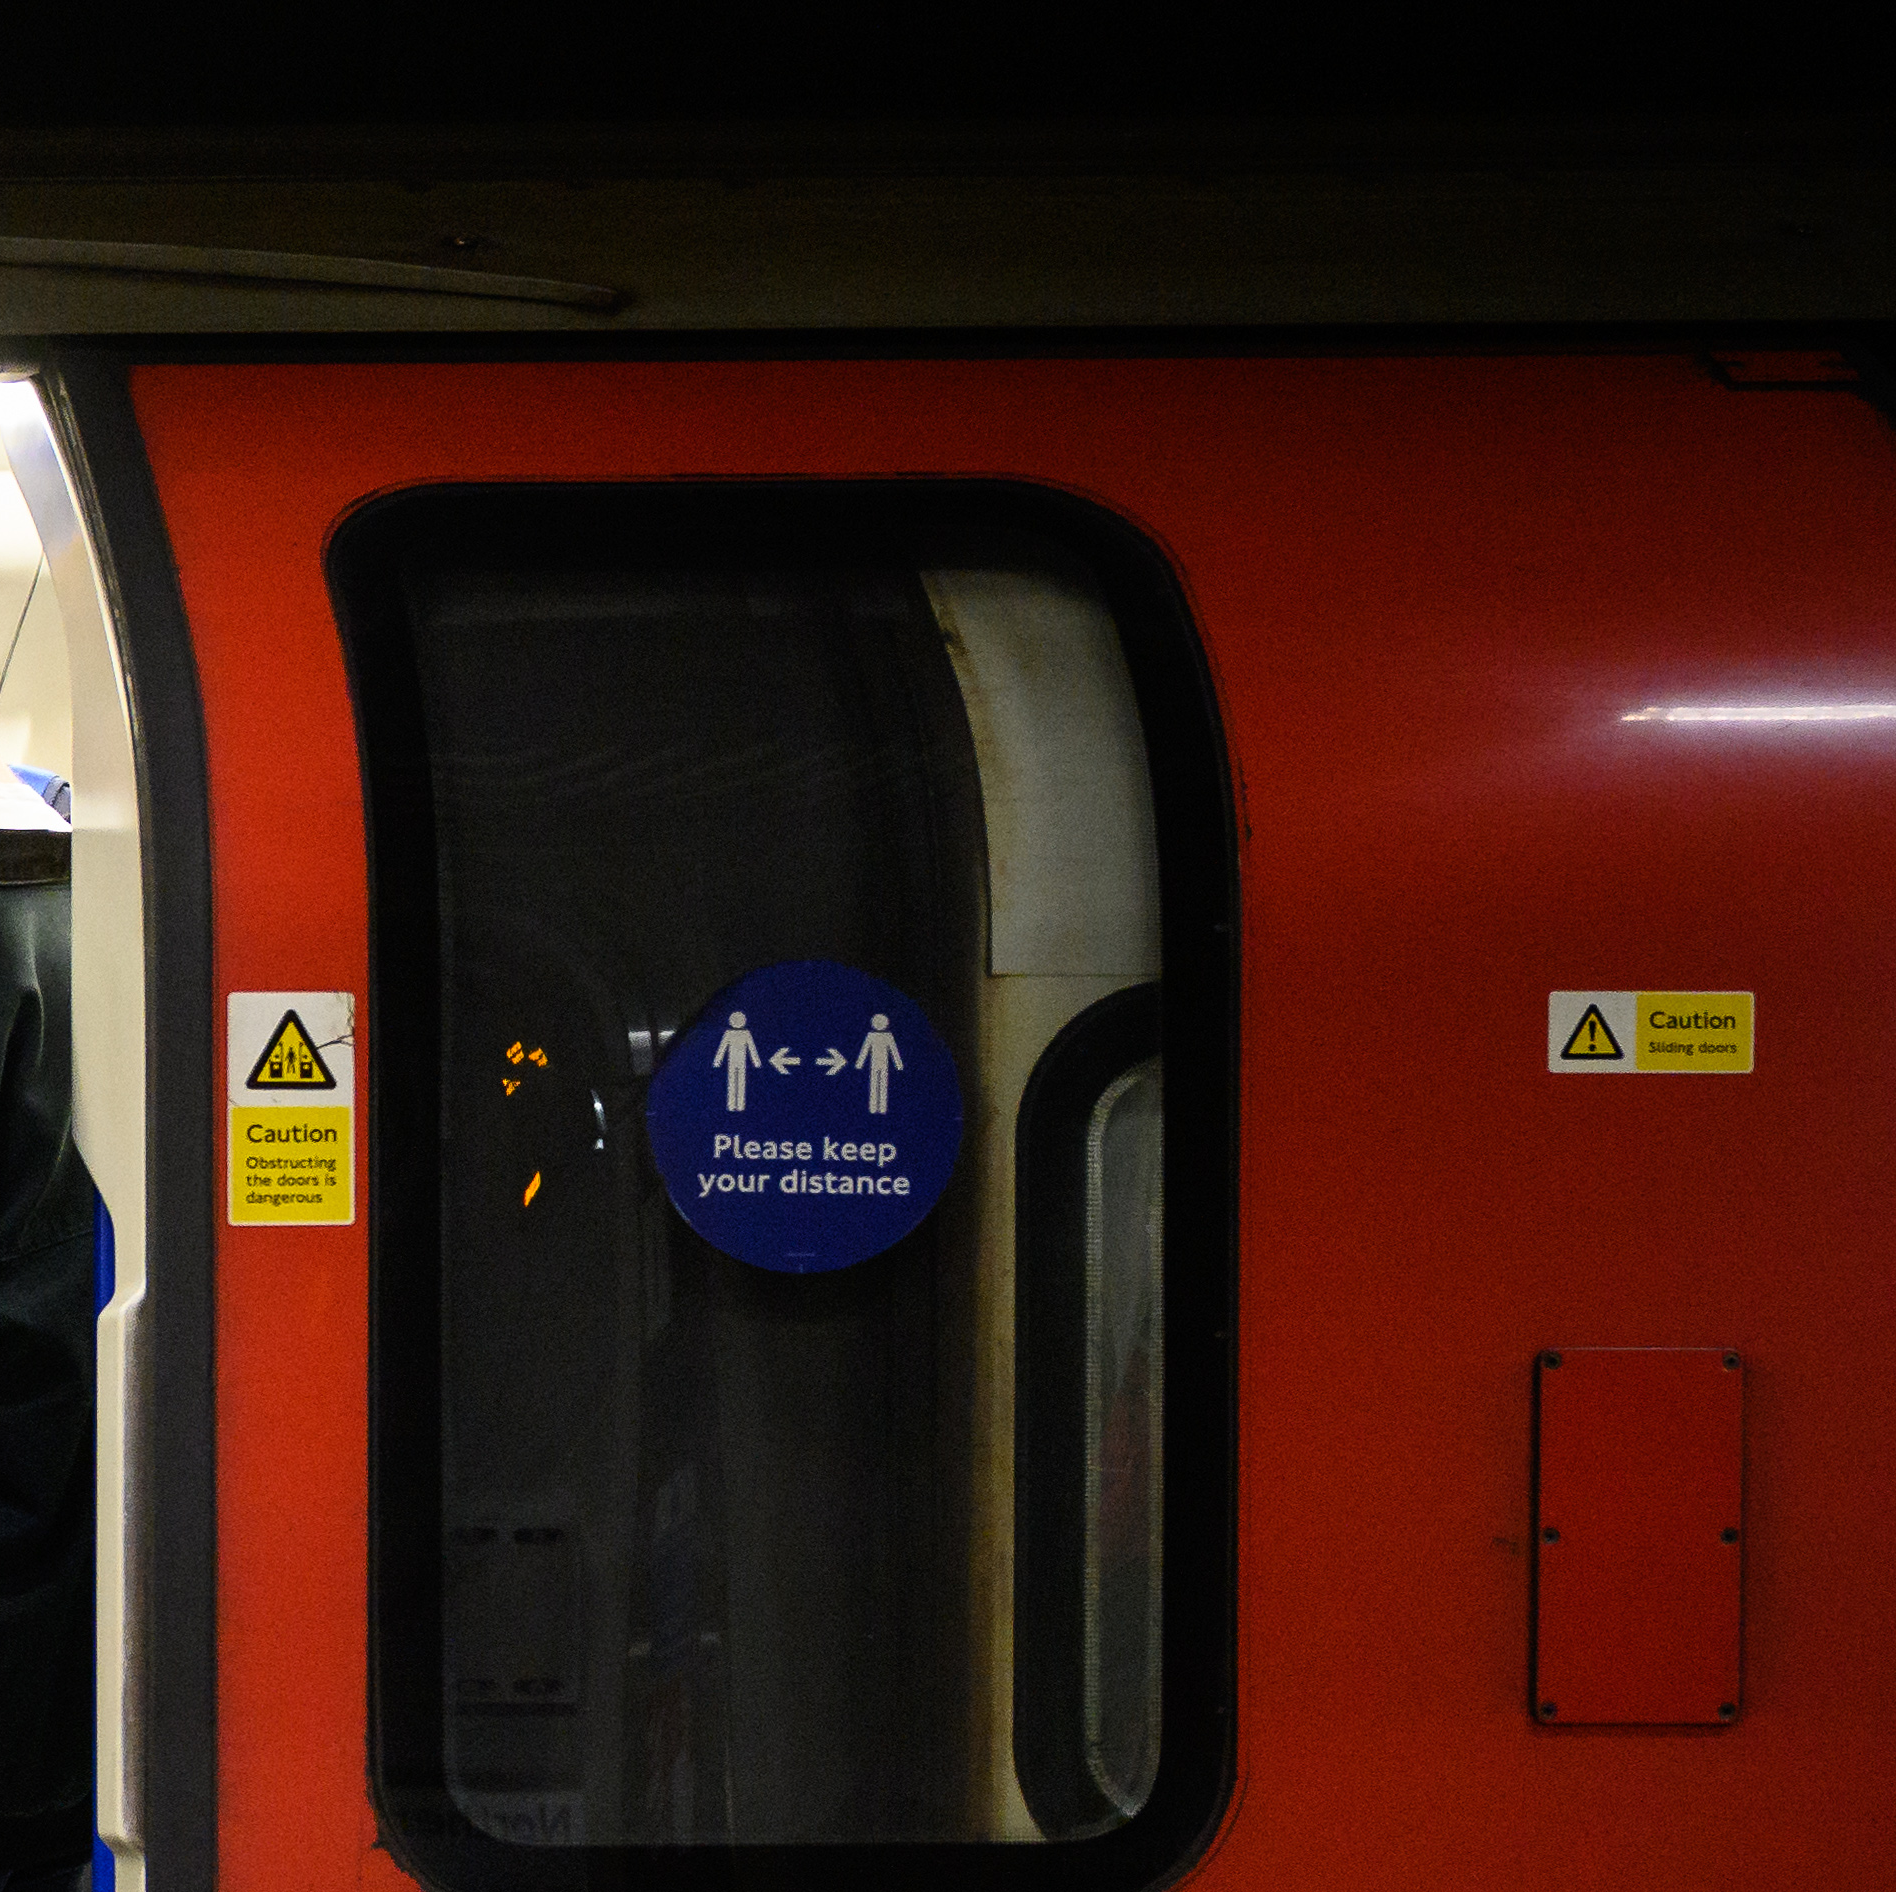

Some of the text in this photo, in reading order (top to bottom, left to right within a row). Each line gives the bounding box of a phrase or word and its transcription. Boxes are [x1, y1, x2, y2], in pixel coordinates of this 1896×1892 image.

[1649, 1009, 1737, 1030] Caution
[1648, 1041, 1739, 1057] Sliding doors
[246, 1122, 337, 1143] Caution
[713, 1133, 897, 1168] Please keep
[246, 1155, 337, 1173] Obstructing
[246, 1174, 337, 1187] the doors is
[697, 1168, 910, 1198] your distance
[246, 1191, 323, 1207] dangerous
